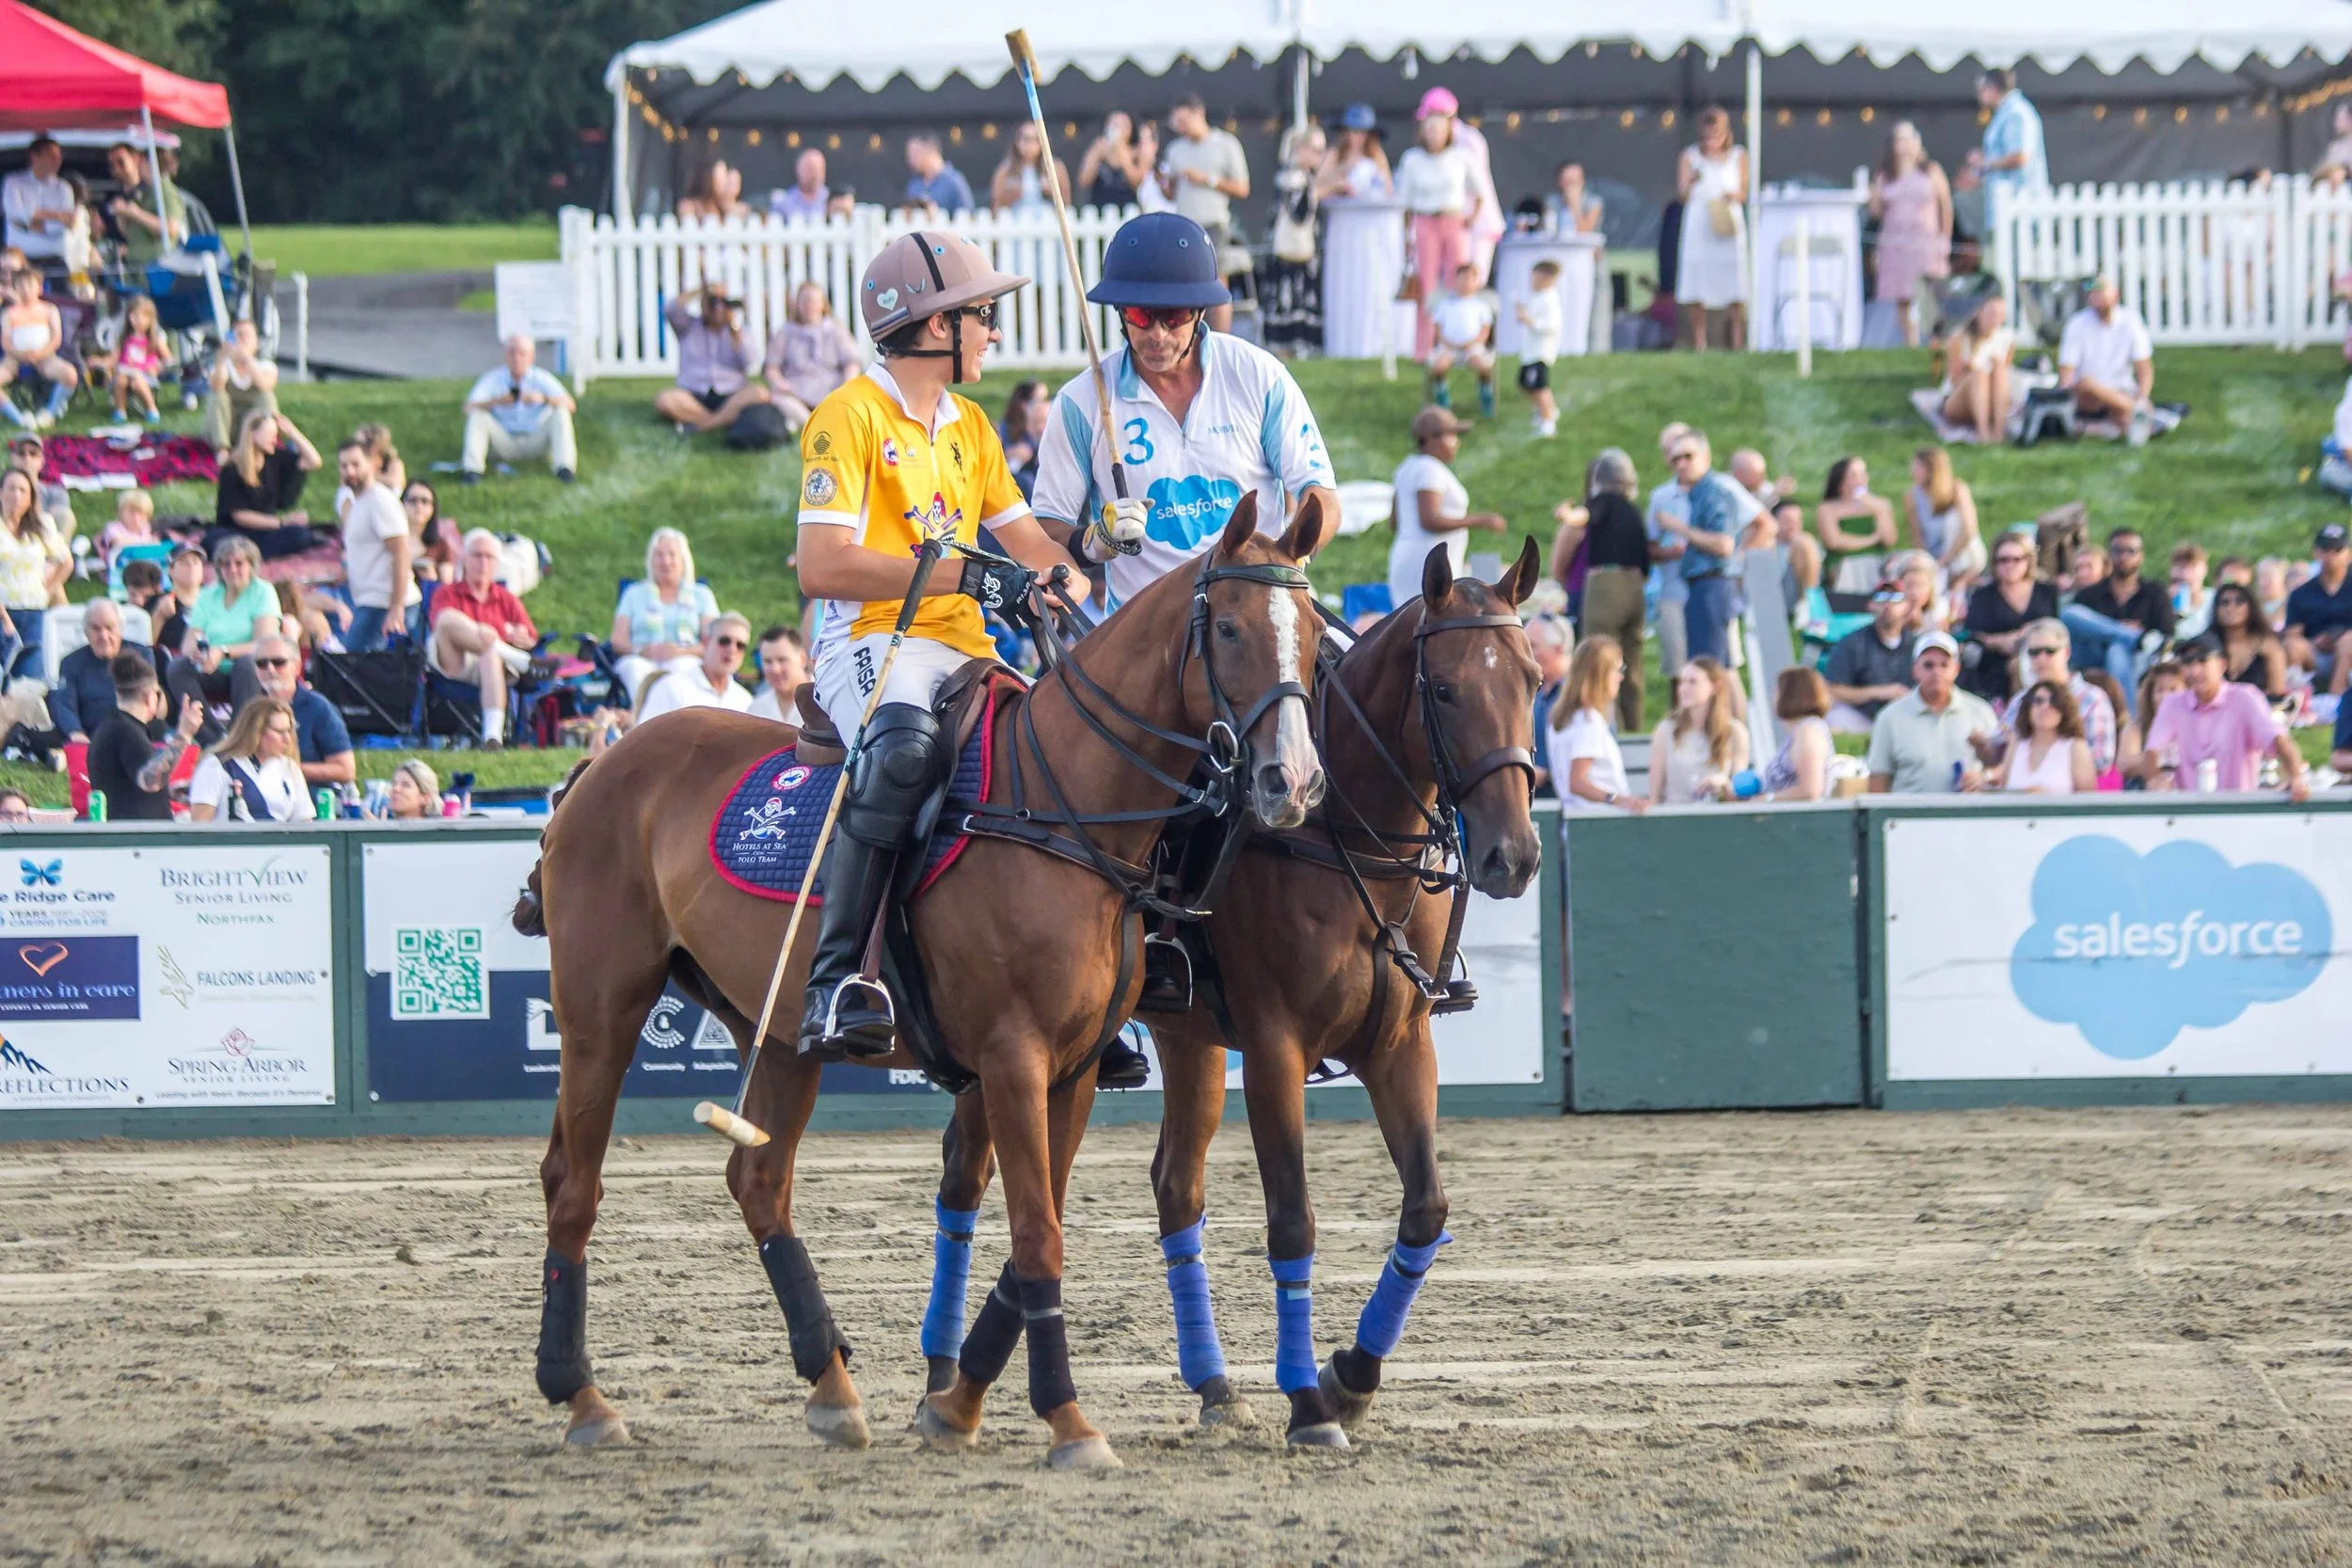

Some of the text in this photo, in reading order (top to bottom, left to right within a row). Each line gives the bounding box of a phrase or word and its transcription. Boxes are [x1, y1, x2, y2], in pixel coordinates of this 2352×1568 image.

[1123, 417, 1154, 466] 3
[1156, 495, 1232, 519] salesforce
[732, 842, 761, 850] HOTELS
[772, 842, 787, 850] SEA
[15, 890, 68, 904] Ridge
[73, 890, 116, 902] Care
[174, 891, 294, 904] SENIOR LIVING
[8, 910, 48, 919] YEARS
[196, 911, 275, 926] NORTHFAX
[2054, 909, 2303, 970] salesforce
[197, 970, 316, 987] FALCONS LANDING
[56, 980, 79, 998] in
[83, 985, 135, 997] care
[167, 1055, 309, 1074] SPRING ARBOR
[0, 1076, 130, 1093] EFLECTIONS
[182, 1075, 291, 1084] SENIOR LIVING
[889, 1069, 928, 1085] FDIC
